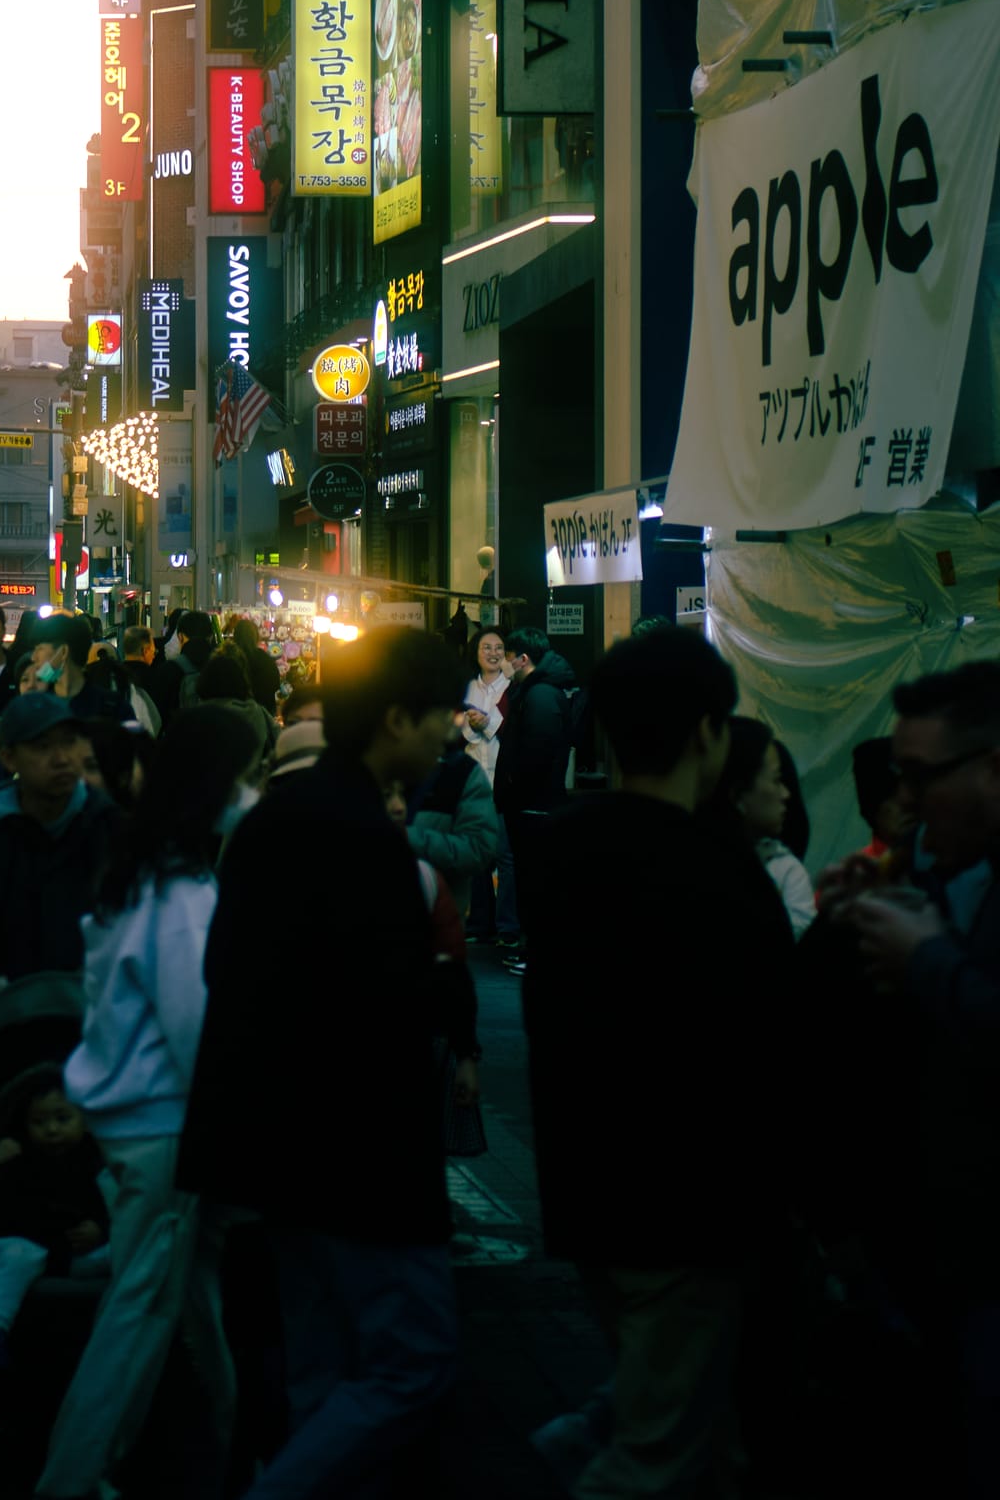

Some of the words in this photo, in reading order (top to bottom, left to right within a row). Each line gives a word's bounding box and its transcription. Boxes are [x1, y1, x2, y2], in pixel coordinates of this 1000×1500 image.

[104, 21, 127, 114] 준오헤어
[121, 112, 141, 143] 2
[310, 0, 353, 165] 황금목장
[231, 76, 244, 155] K-BEAUTY
[155, 149, 193, 179] JUNO
[352, 151, 366, 161] 3F
[104, 179, 126, 196] 3F
[231, 159, 244, 206] SHOP
[298, 174, 368, 188] T.753-3536
[728, 74, 939, 367] apple
[227, 244, 250, 326] SAVOY
[387, 270, 424, 322] 황금목장
[152, 292, 170, 407] MEDIHEAL
[229, 332, 250, 370] HO
[335, 378, 350, 396] 肉
[319, 410, 364, 426] 피부과
[319, 431, 364, 448] 전문의
[886, 425, 932, 490] 営業
[93, 508, 118, 536] 光
[551, 511, 588, 575] apple
[589, 510, 620, 558] かばん
